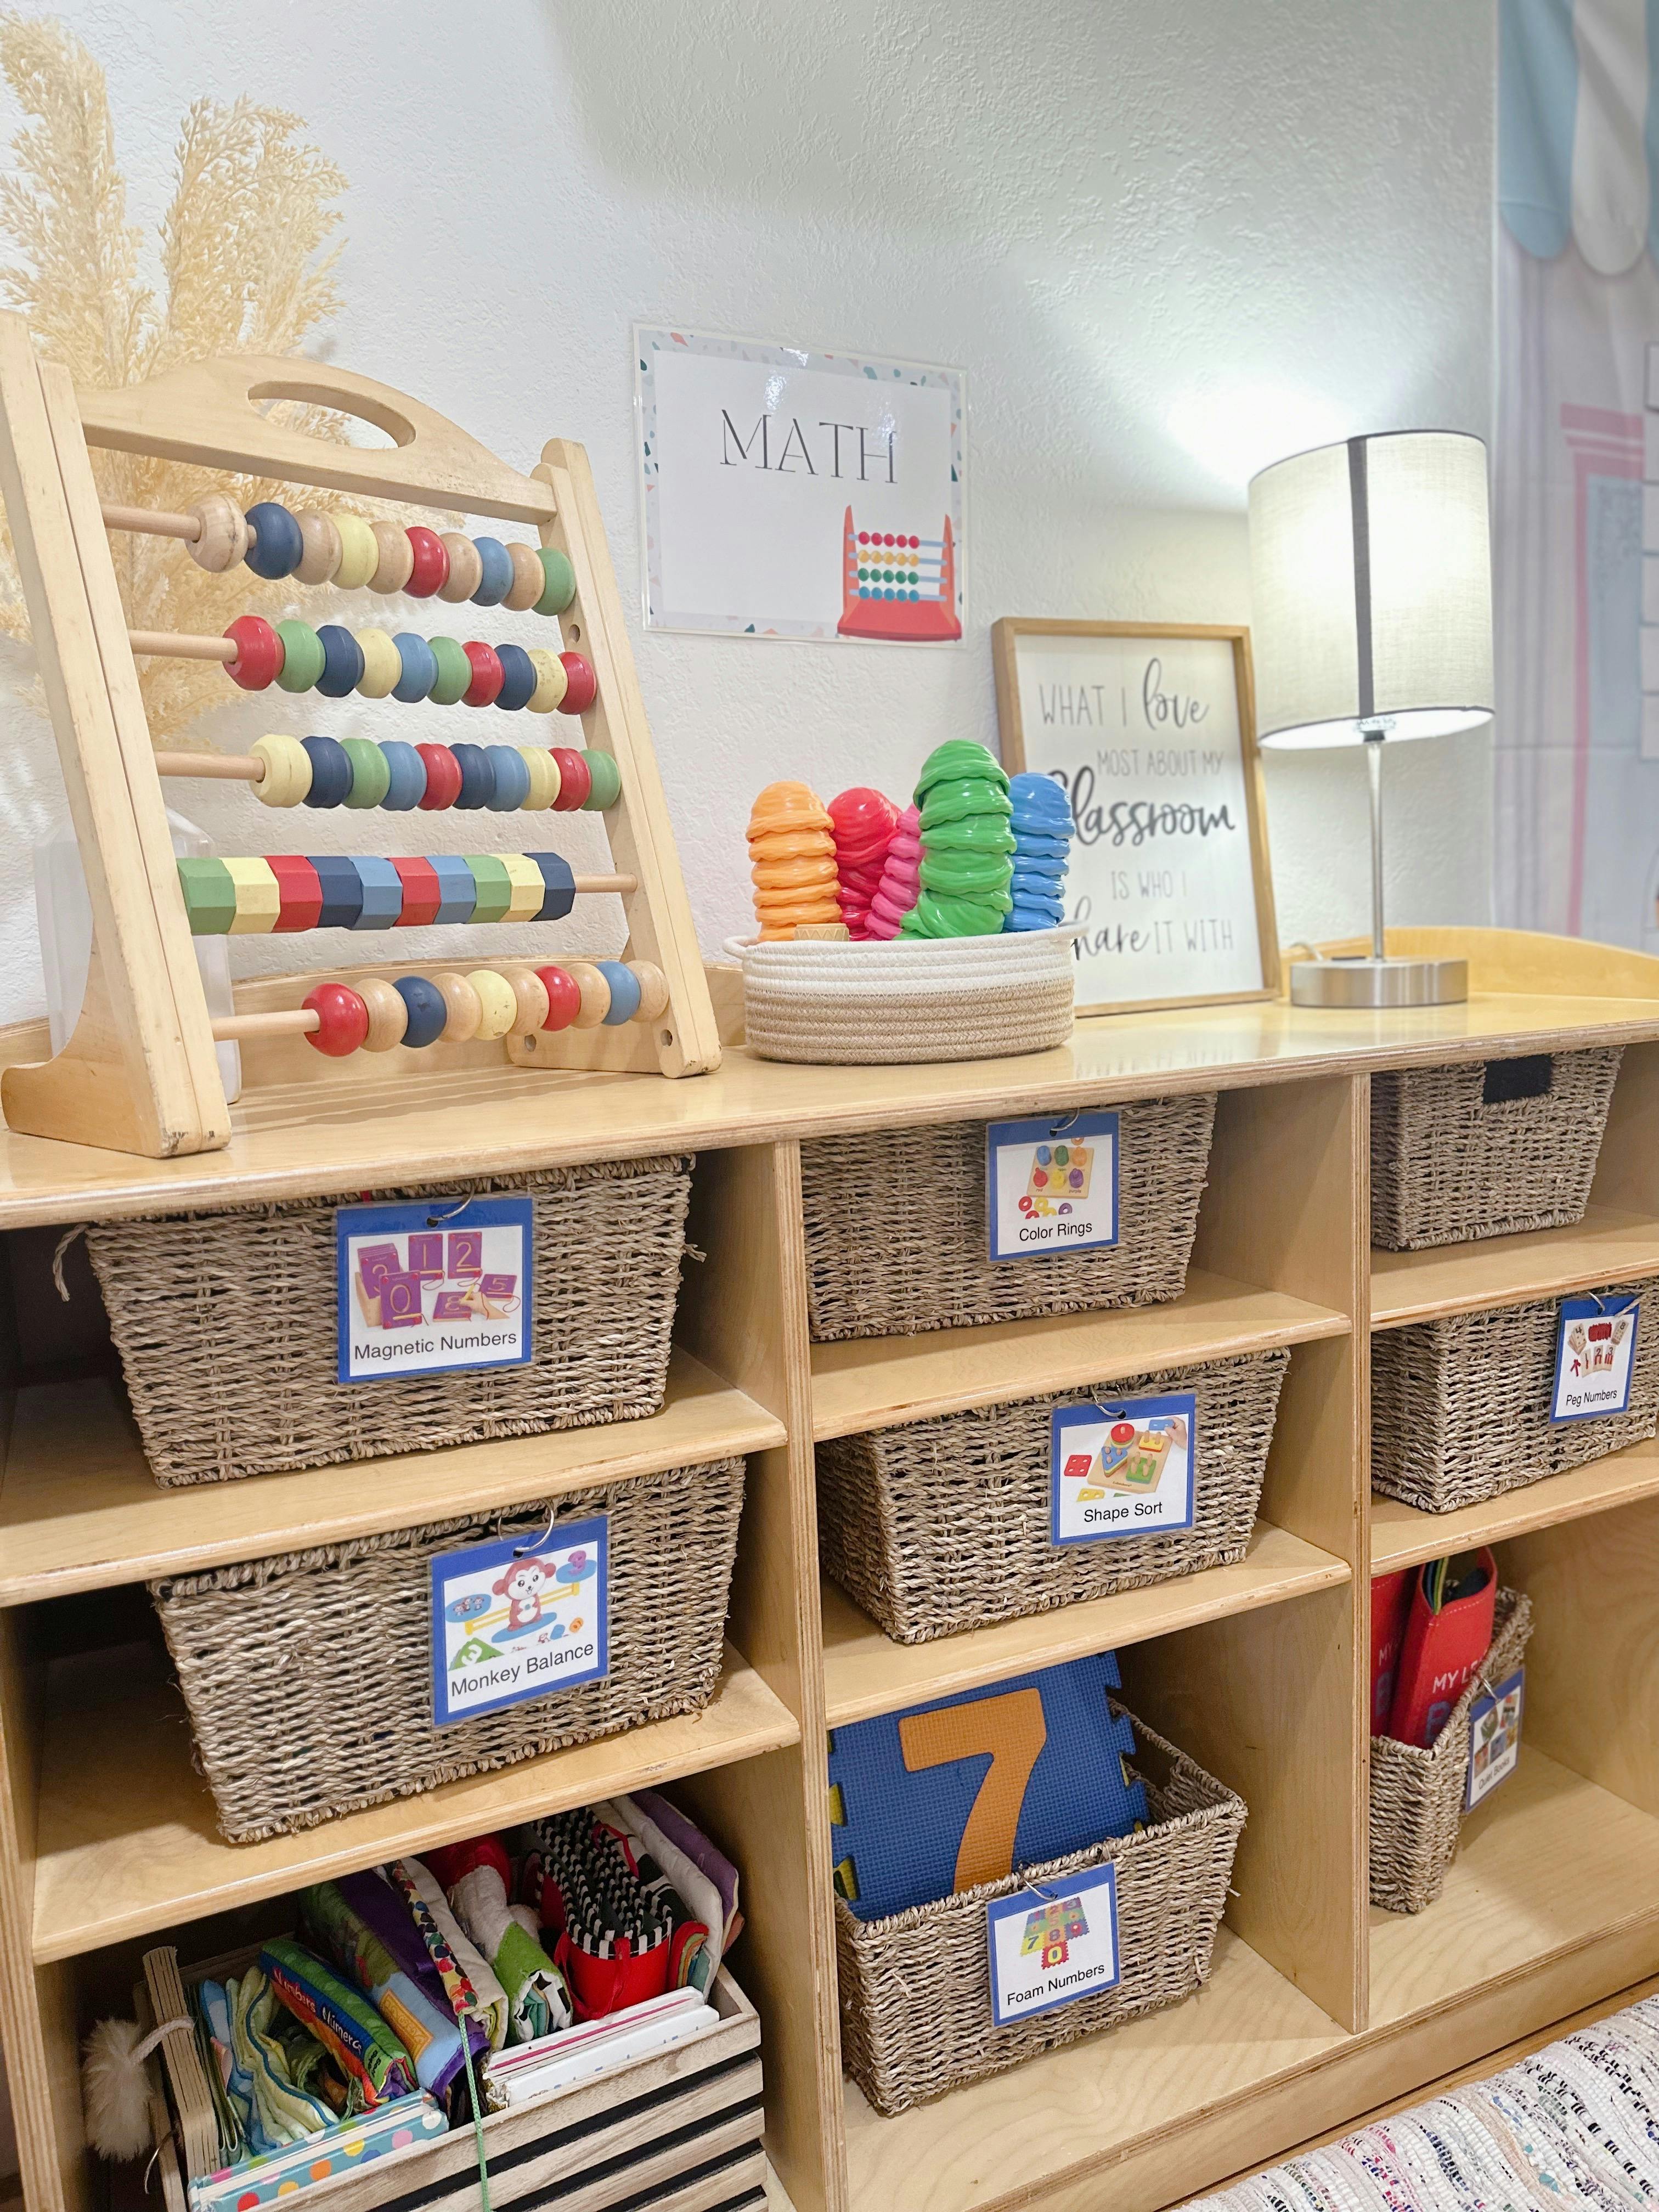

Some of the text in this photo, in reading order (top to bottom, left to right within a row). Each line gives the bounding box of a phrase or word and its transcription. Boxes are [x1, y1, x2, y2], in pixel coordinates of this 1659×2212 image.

[720, 409, 898, 484] MATH
[1039, 658, 1210, 730] WHAT I love
[1097, 749, 1224, 776] MOST ABOUT MY
[1110, 870, 1130, 900] IS
[1138, 870, 1173, 898] WHO
[1070, 895, 1234, 961] hare IT WITH
[1019, 1222, 1093, 1242] Color Rings
[456, 1242, 472, 1267] 2
[488, 1278, 509, 1291] 5
[354, 1332, 517, 1361] Magnetic Numbers
[1565, 1390, 1617, 1407] Peg Numbers
[1084, 1502, 1163, 1522] Shape Sort
[452, 1644, 594, 1697] Monkey Balance
[1432, 1669, 1459, 1694] MY
[898, 1687, 1047, 1893] 7
[1007, 1964, 1105, 2006] Foam Numbers
